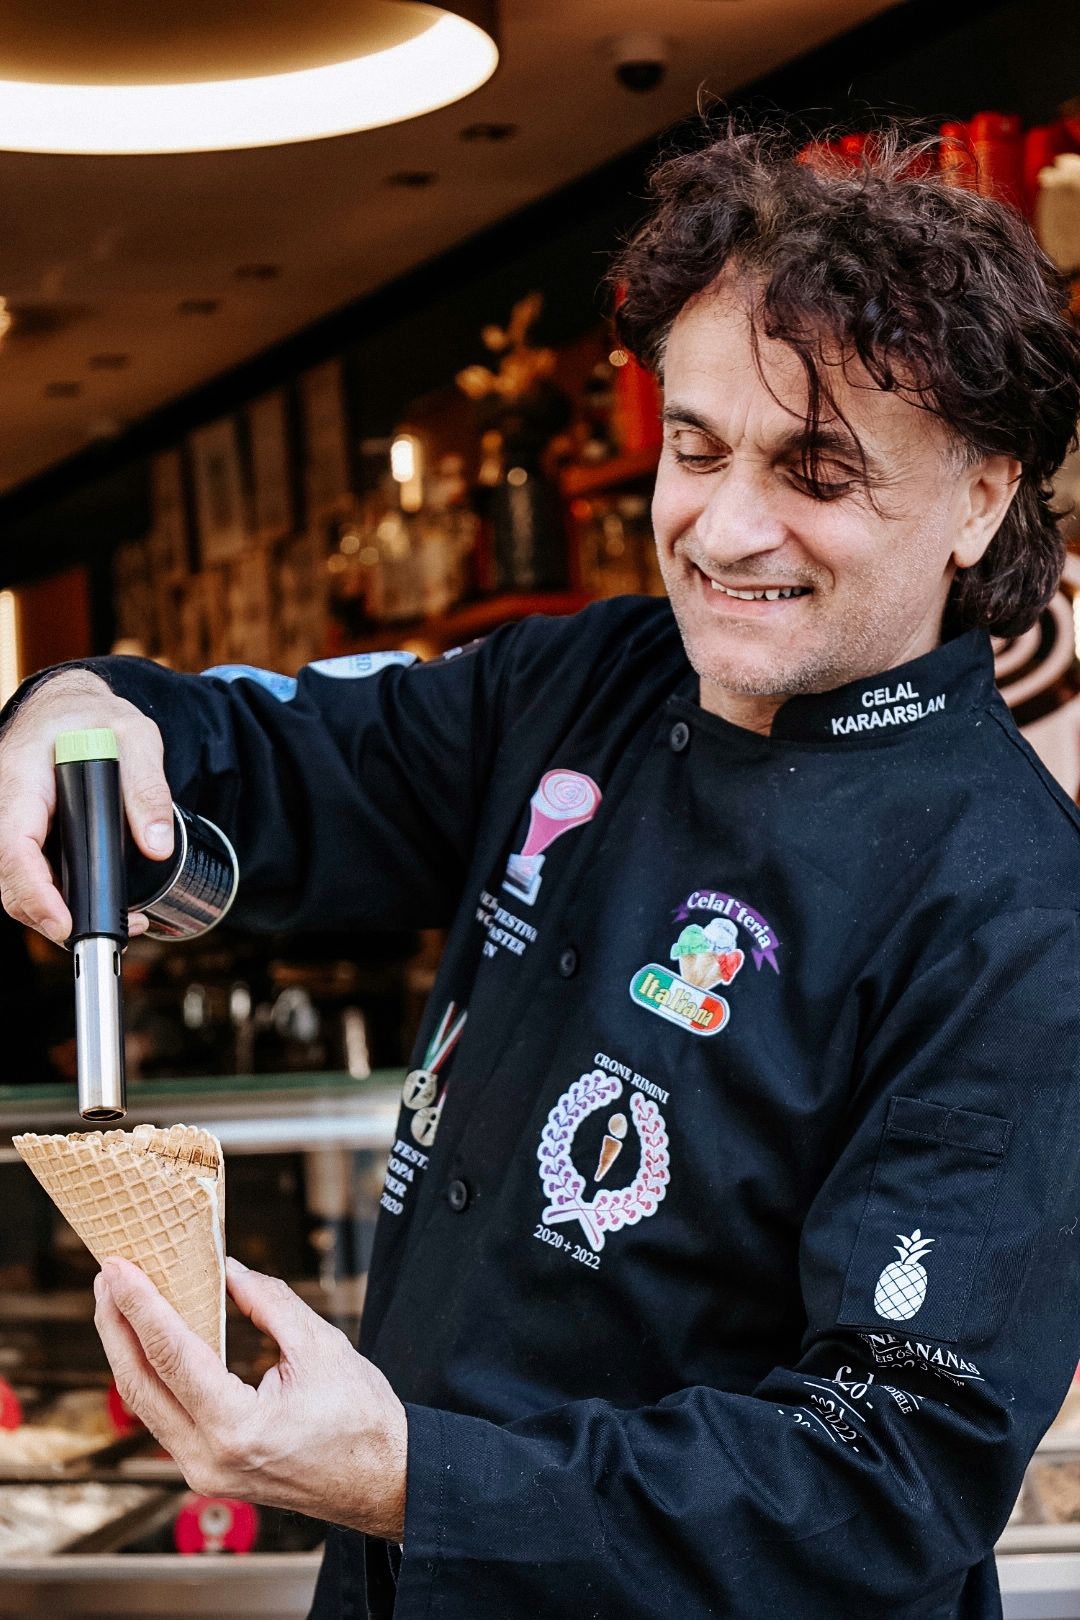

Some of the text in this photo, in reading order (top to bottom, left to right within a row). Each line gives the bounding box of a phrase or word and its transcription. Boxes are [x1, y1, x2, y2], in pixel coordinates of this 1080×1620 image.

[831, 693, 945, 735] KARAARSLAN
[861, 681, 919, 707] CELAL
[594, 1052, 670, 1104] CRONE RIMINI
[533, 1224, 563, 1247] 2020
[571, 1248, 601, 1270] 2022
